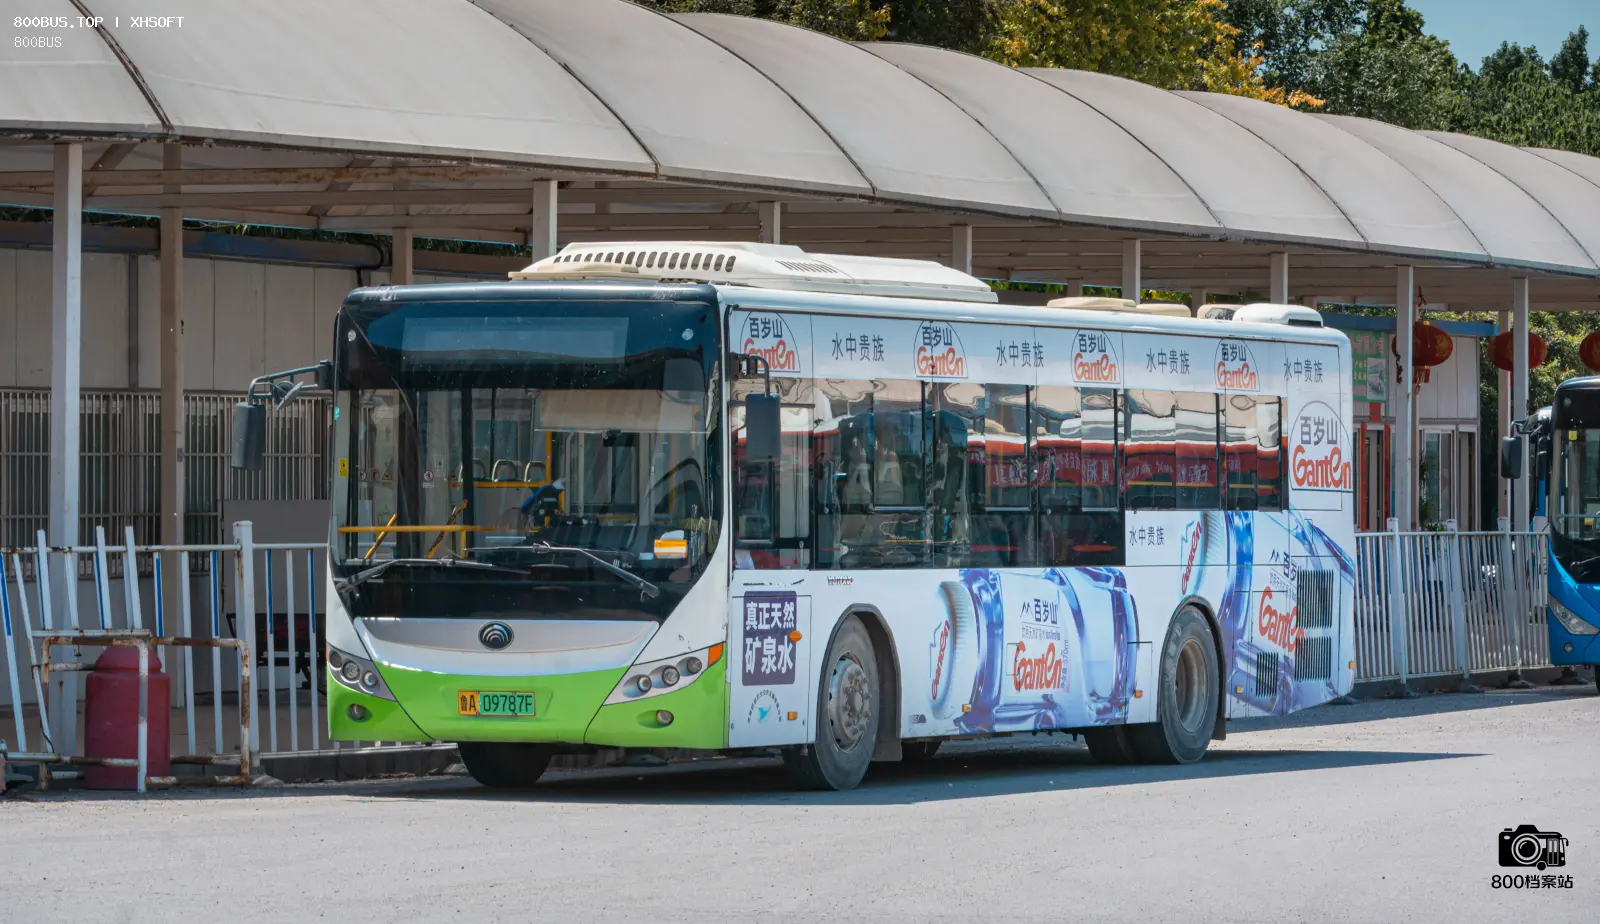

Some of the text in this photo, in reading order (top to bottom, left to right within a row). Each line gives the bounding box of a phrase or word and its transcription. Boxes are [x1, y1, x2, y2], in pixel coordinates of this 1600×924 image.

[748, 317, 783, 339] 百岁山
[922, 326, 953, 347] 百岁山
[831, 333, 885, 362] 水中贵族
[996, 340, 1044, 369] 水中贵族
[1078, 333, 1107, 354] 百岁山
[1220, 343, 1247, 363] 百岁山
[916, 345, 964, 377] Ganten
[1074, 352, 1117, 383] Ganten
[1146, 348, 1190, 375] 水中贵族
[1217, 361, 1256, 390] Ganten
[1283, 358, 1323, 383] 水中贵族
[1300, 416, 1337, 446] 百岁山
[1292, 445, 1351, 489] Ganten
[1128, 526, 1165, 546] 水中贵族
[745, 601, 795, 630] 真正天然
[1034, 598, 1058, 625] 百岁山
[745, 635, 794, 675] 矿泉水
[1013, 641, 1062, 692] Ganten
[460, 694, 533, 713] 鲁A 09787F
